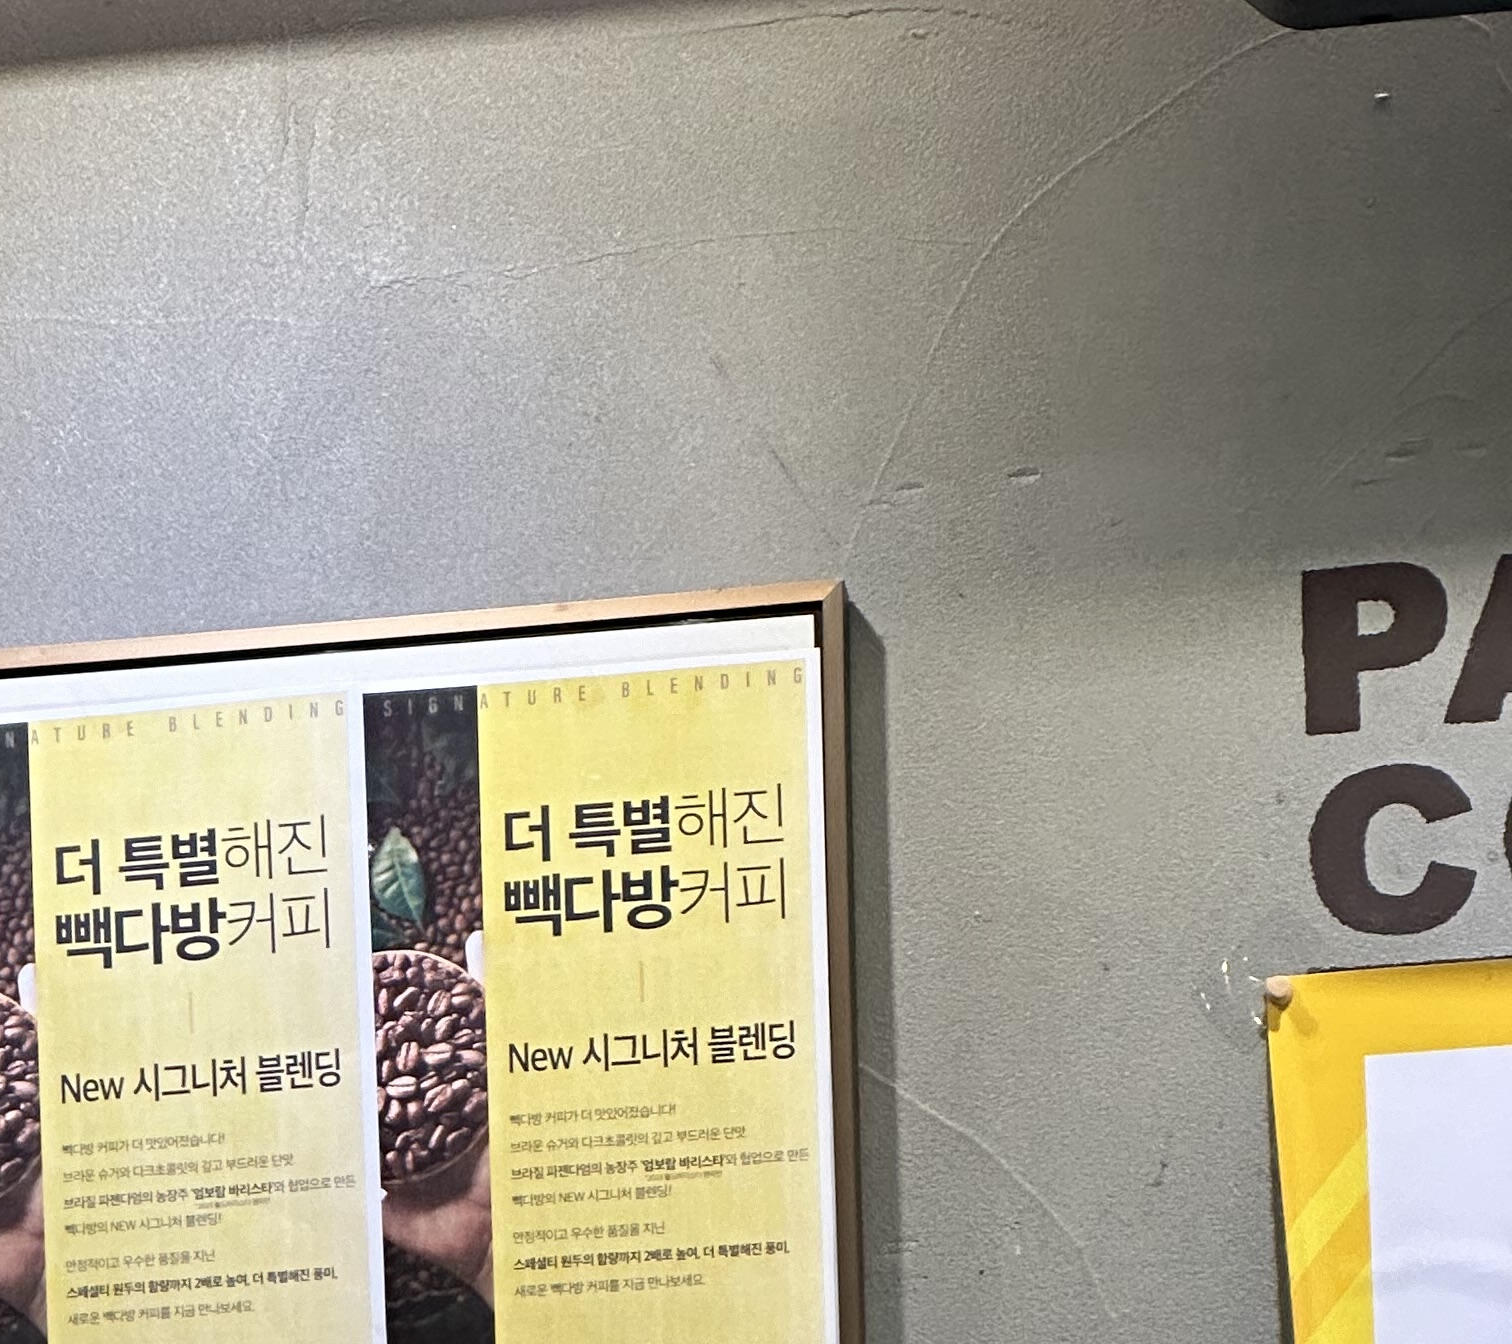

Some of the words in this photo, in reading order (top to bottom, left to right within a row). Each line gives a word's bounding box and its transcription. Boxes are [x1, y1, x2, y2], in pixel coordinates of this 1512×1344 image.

[168, 699, 346, 733] BLENDING
[383, 684, 587, 718] SIGNATURE
[621, 666, 805, 699] BLENDING
[54, 838, 102, 895] 더
[118, 814, 329, 891] 특별해진
[503, 804, 551, 862] 더
[568, 782, 786, 858] 특별해진
[1309, 763, 1512, 936] C
[54, 887, 332, 969] 빽다방커피
[503, 857, 787, 937] 빽다방커피
[60, 1072, 124, 1105] New
[133, 1056, 247, 1102] 시그니처
[254, 1047, 342, 1094] 블렌딩
[508, 1042, 573, 1074] New
[582, 1026, 700, 1072] 시그니처
[707, 1019, 797, 1065] 블렌딩
